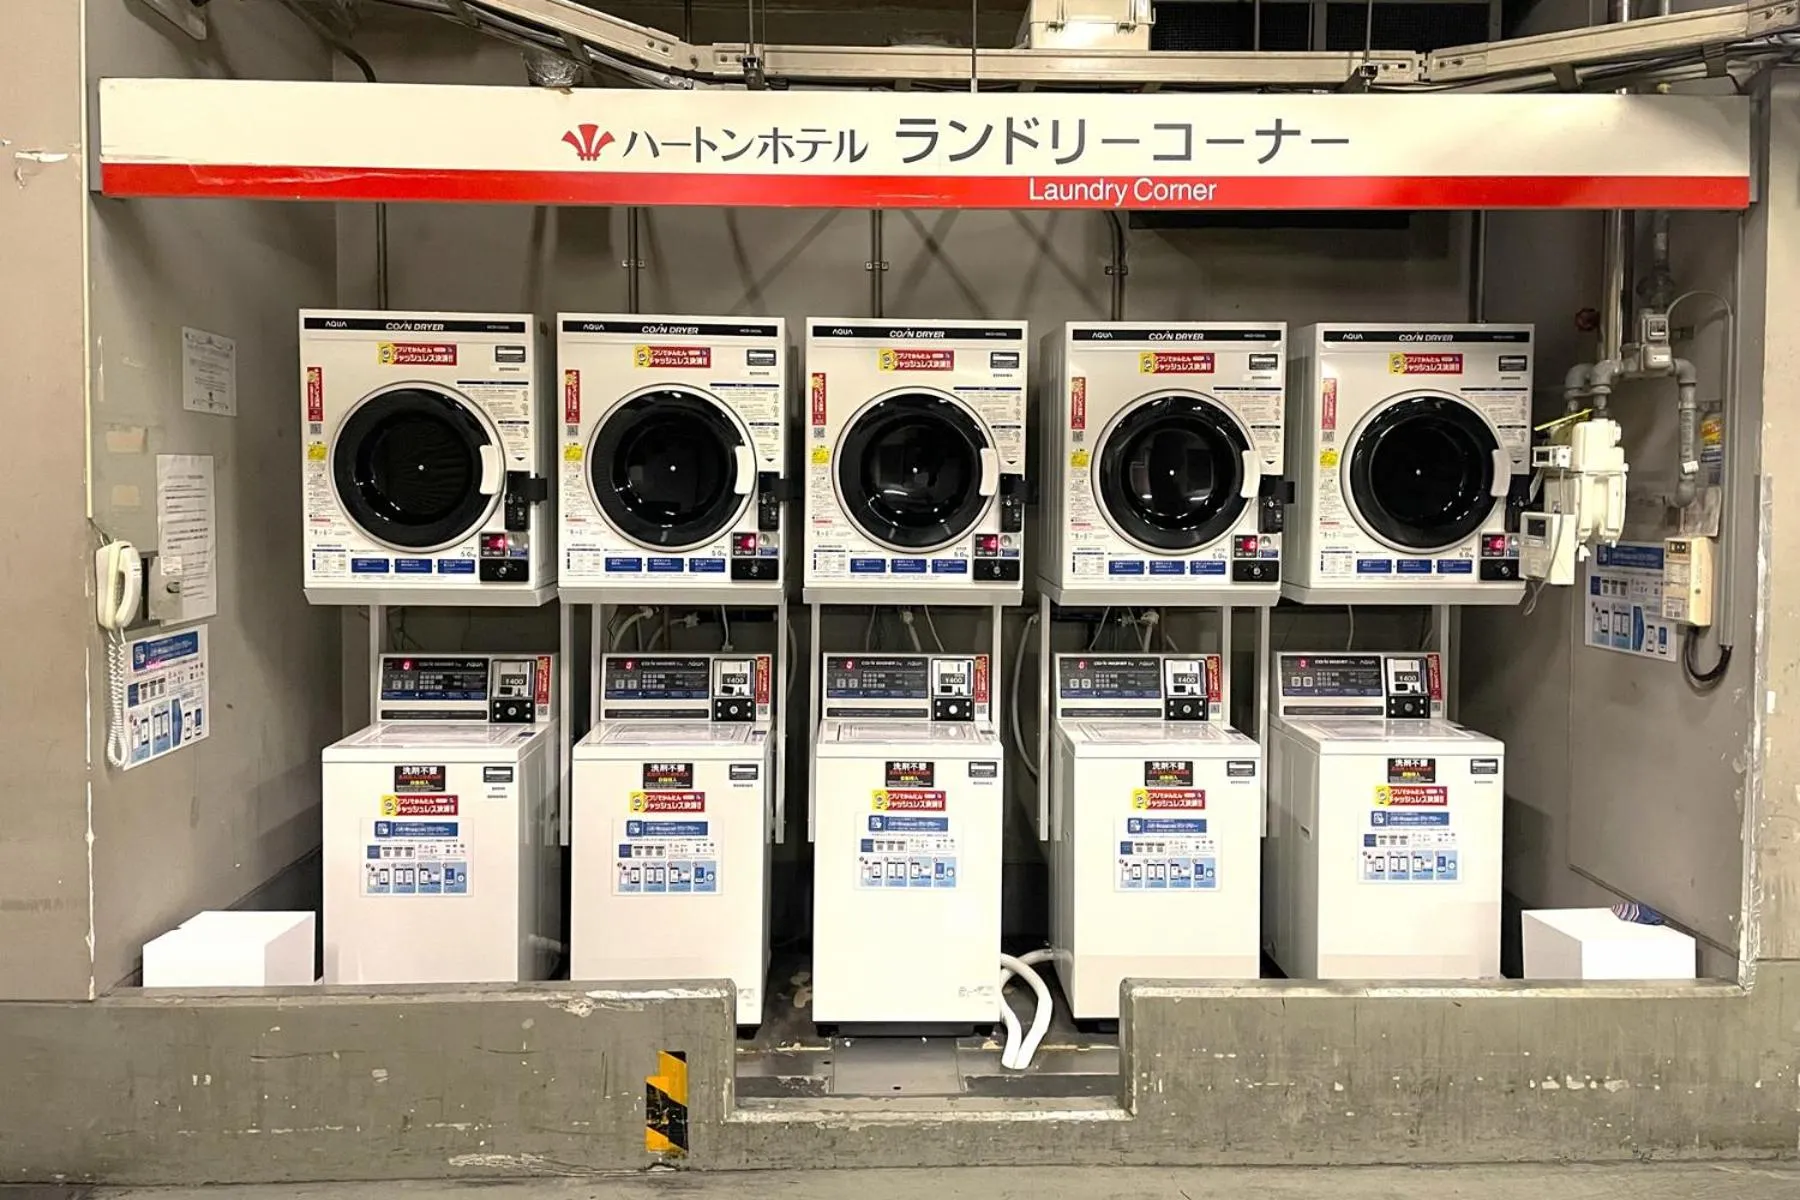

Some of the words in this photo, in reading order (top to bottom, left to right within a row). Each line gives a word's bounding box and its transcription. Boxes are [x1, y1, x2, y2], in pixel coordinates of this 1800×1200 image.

[622, 126, 868, 164] ハートンホテル
[896, 116, 1350, 164] ランドリーコーナー
[1029, 178, 1129, 206] Laundry
[1133, 178, 1218, 200] Corner
[325, 320, 347, 328] AQUA
[414, 322, 444, 331] DRYER
[583, 323, 605, 331] AQUA
[668, 326, 699, 334] DRYER
[832, 328, 853, 336] AQUA
[916, 330, 945, 338] DRYER
[1091, 331, 1113, 339] AQUA
[1175, 333, 1204, 341] DRYER
